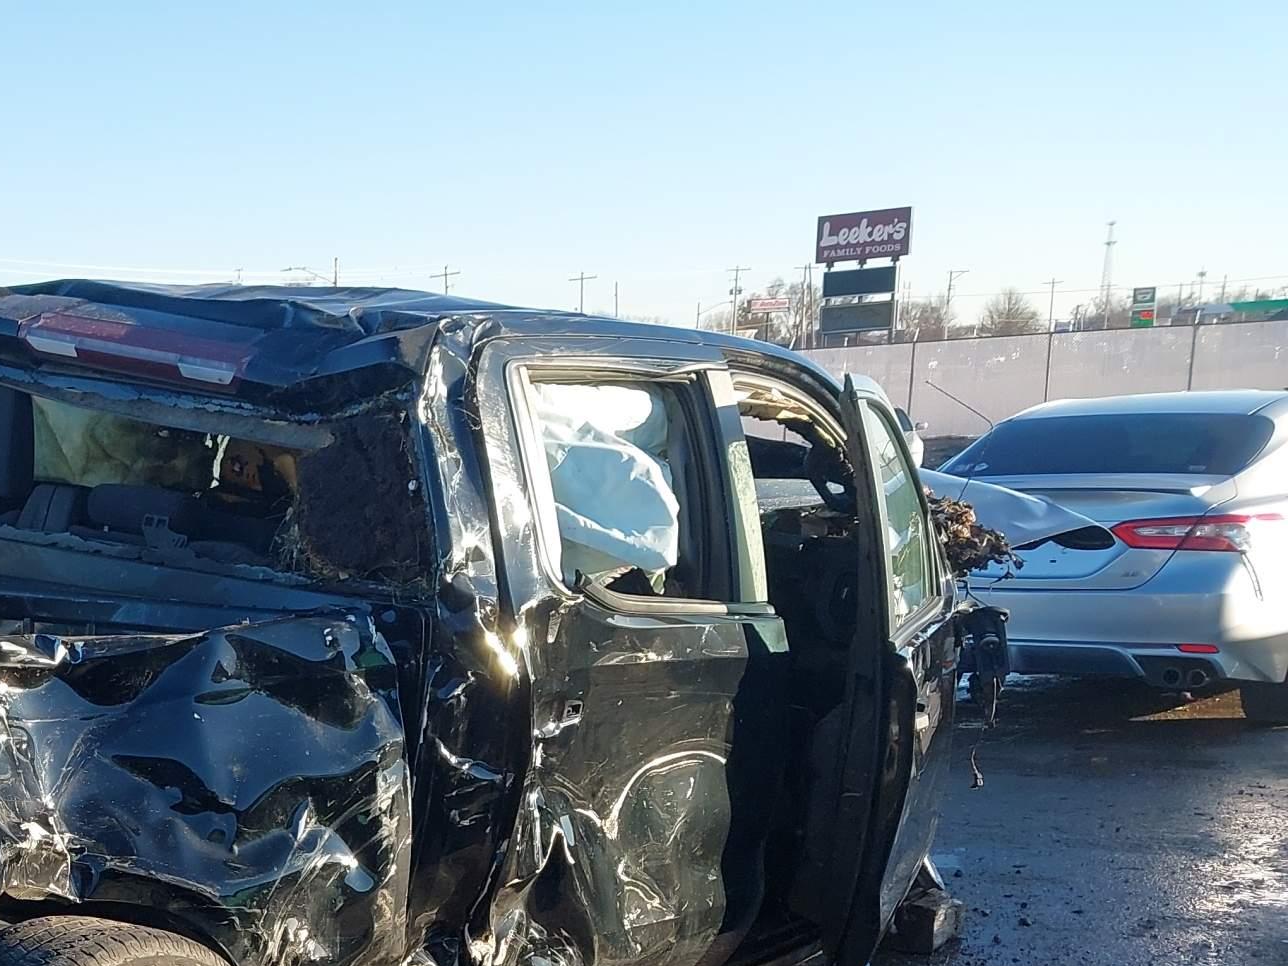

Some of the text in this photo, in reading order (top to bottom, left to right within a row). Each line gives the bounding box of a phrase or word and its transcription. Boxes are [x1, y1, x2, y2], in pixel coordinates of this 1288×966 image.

[819, 218, 907, 247] Leeker's
[823, 243, 902, 258] FAMILY FOODS
